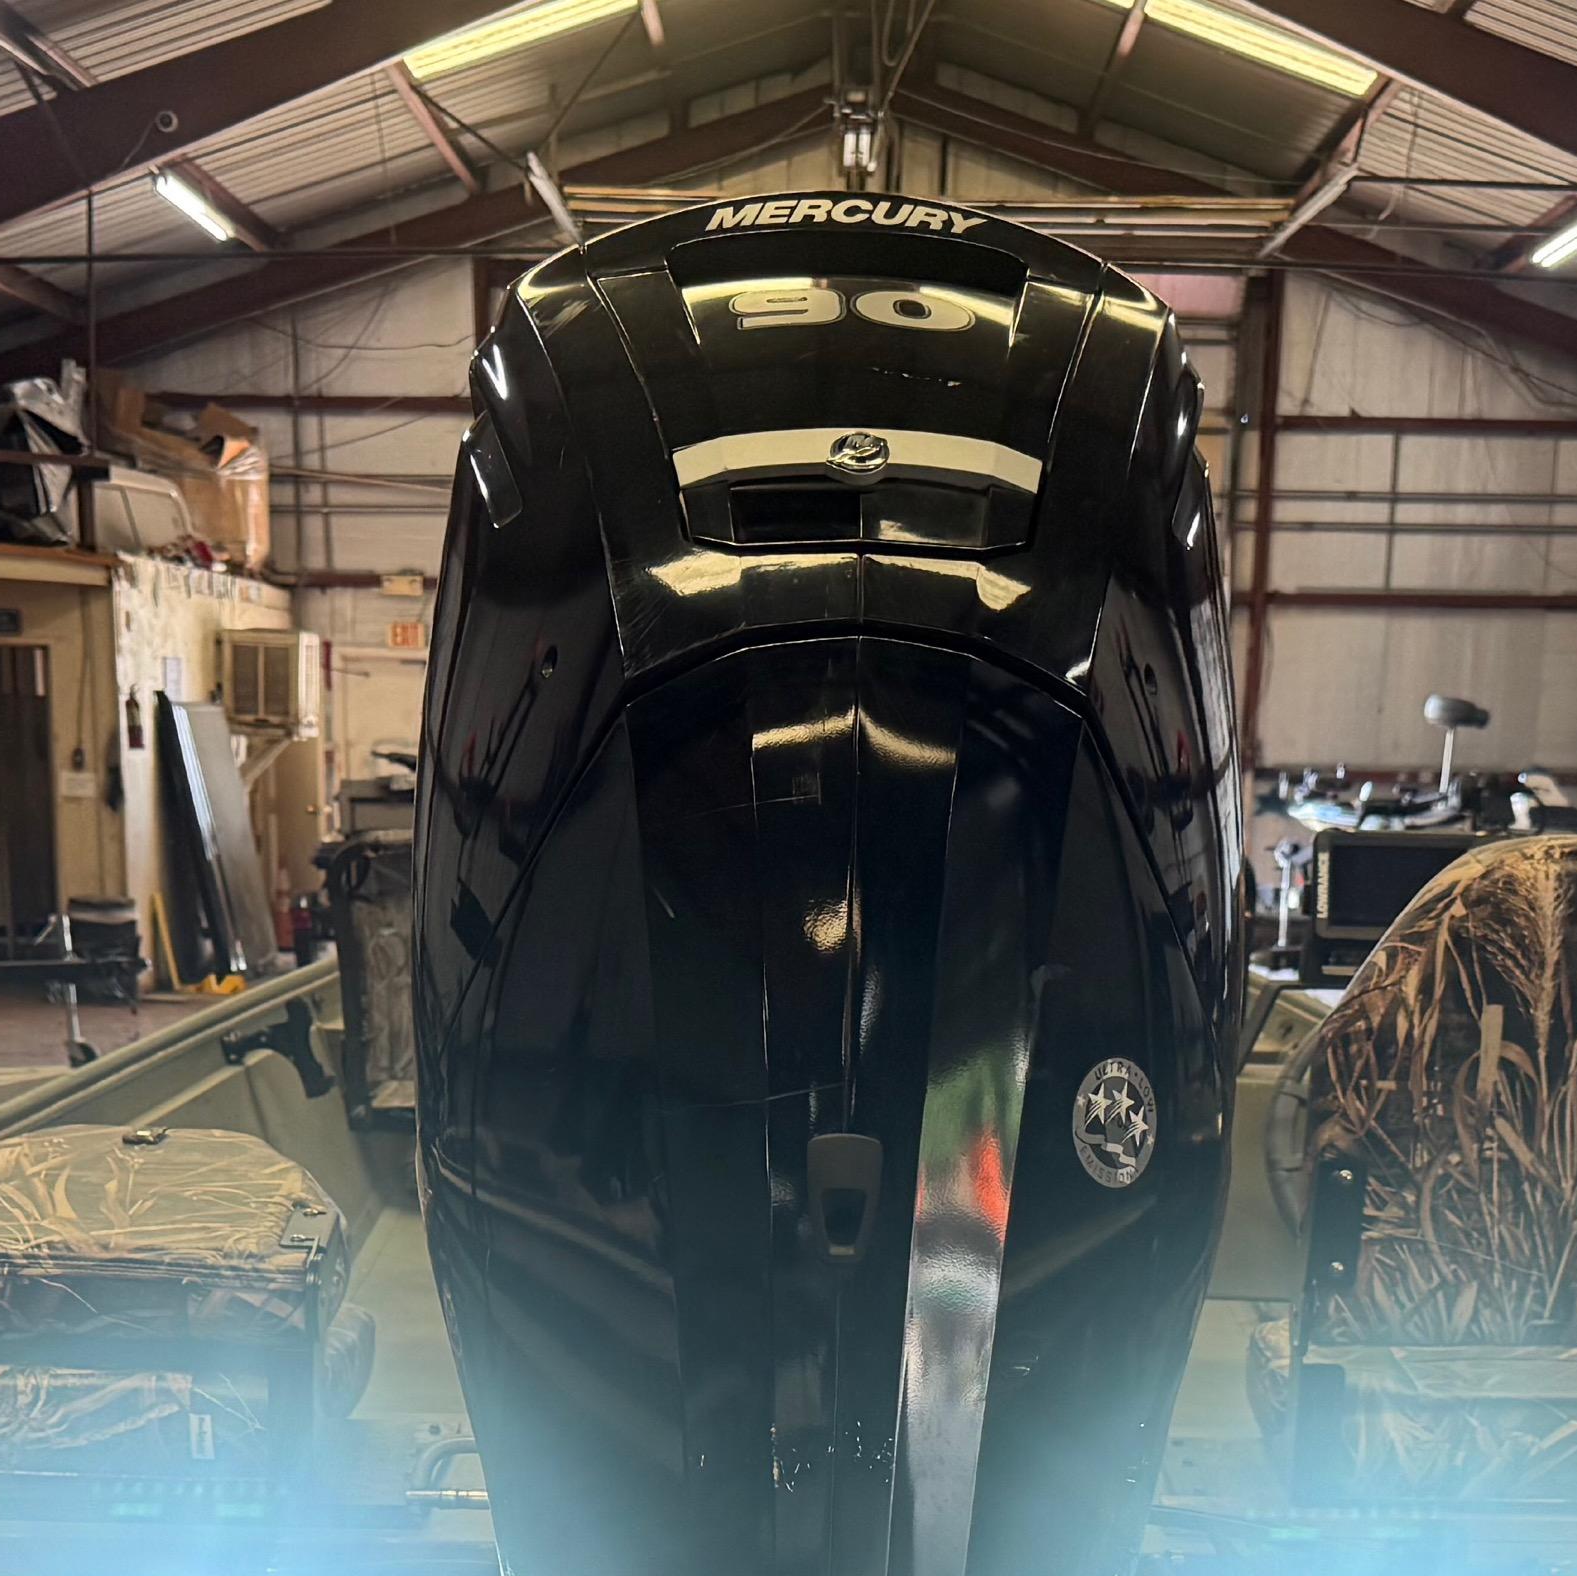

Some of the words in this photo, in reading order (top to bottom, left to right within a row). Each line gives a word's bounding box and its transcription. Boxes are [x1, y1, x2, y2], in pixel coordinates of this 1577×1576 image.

[705, 199, 987, 234] MERCURY
[729, 288, 976, 332] 90
[1317, 852, 1330, 918] LOWRANCE
[1094, 1060, 1132, 1081] ULTRA
